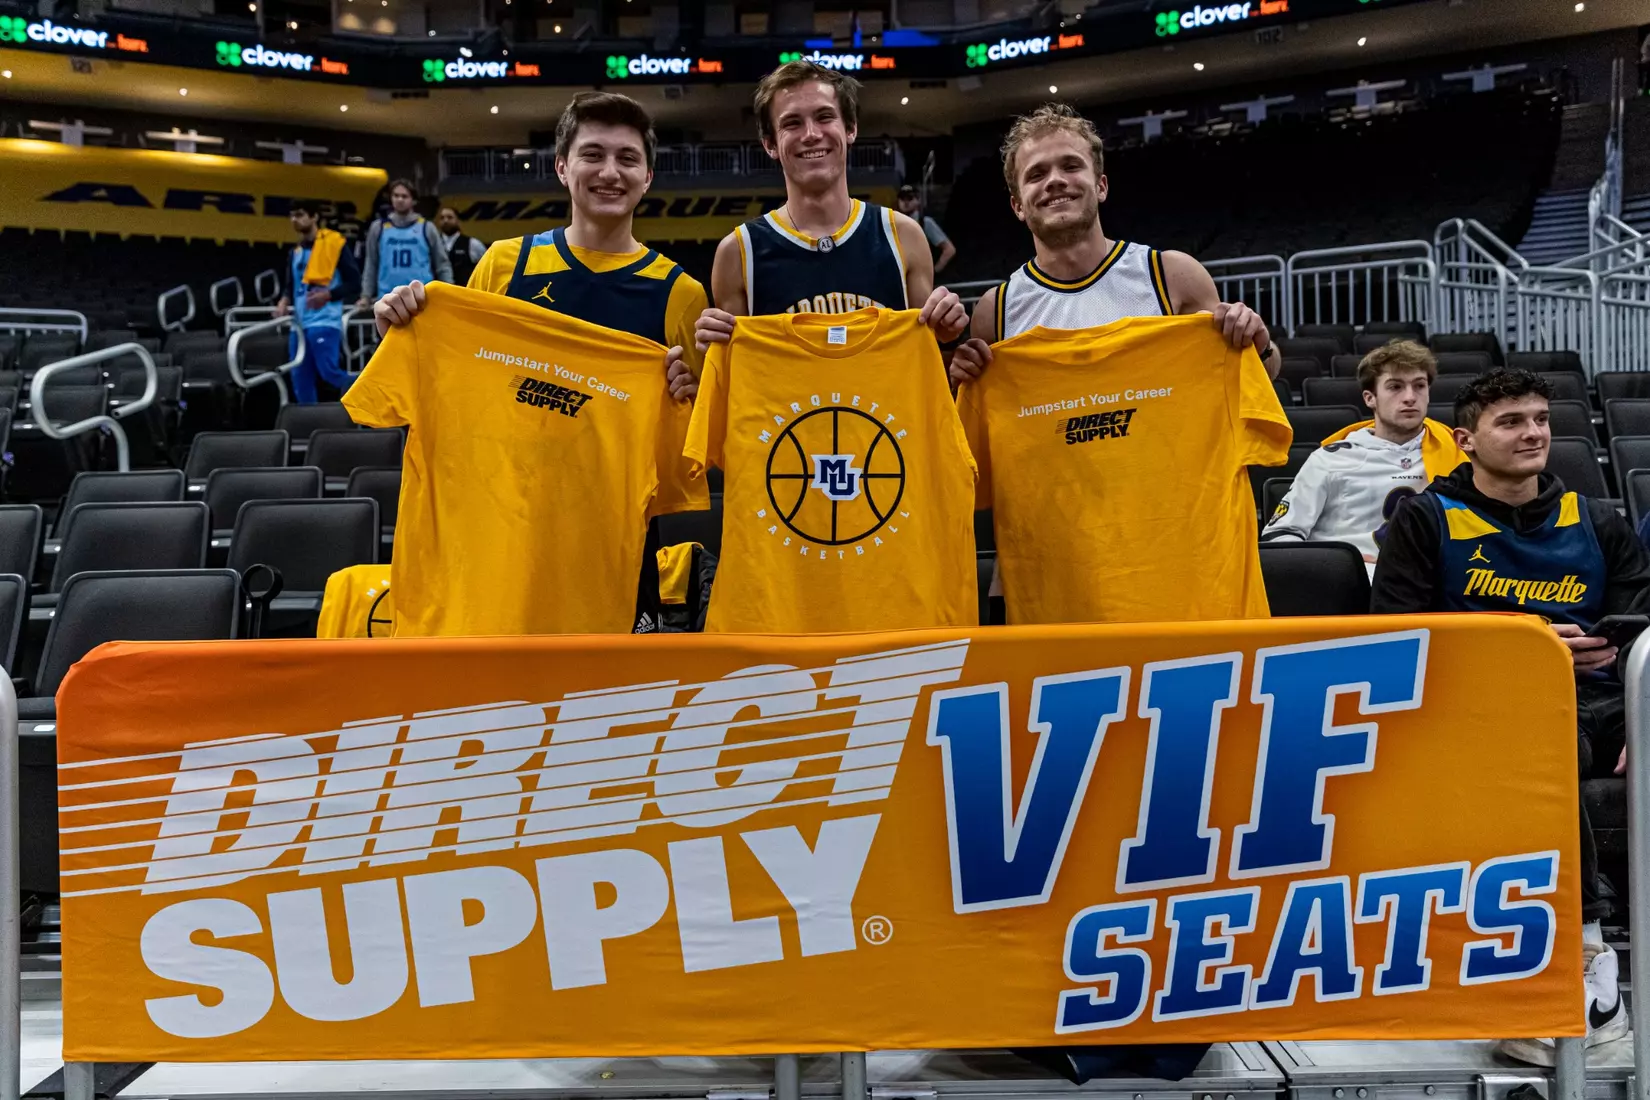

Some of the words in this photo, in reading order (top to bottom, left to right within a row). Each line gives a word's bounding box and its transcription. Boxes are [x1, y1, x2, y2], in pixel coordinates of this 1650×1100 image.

[1180, 1, 1251, 29] clover
[27, 18, 108, 48] clover
[988, 36, 1051, 60] clover
[241, 44, 313, 71] clover
[445, 57, 508, 78] clover
[628, 54, 691, 74] clover
[393, 249, 412, 268] 10
[474, 347, 550, 373] Jumpstart
[554, 364, 585, 384] Your
[587, 377, 631, 402] Career
[517, 377, 594, 408] DIRECT
[1017, 396, 1085, 418] Jumpstart
[1089, 393, 1120, 406] Your
[1124, 386, 1173, 401] Career
[758, 392, 908, 443] MARQUETTE
[1063, 408, 1138, 432] DIRECT
[815, 457, 859, 498] MU
[757, 508, 910, 560] BASKETBALL
[1463, 568, 1587, 605] Marquette
[139, 638, 970, 896] DIRECT
[926, 628, 1430, 914] VIF
[1056, 849, 1560, 1035] SEATS
